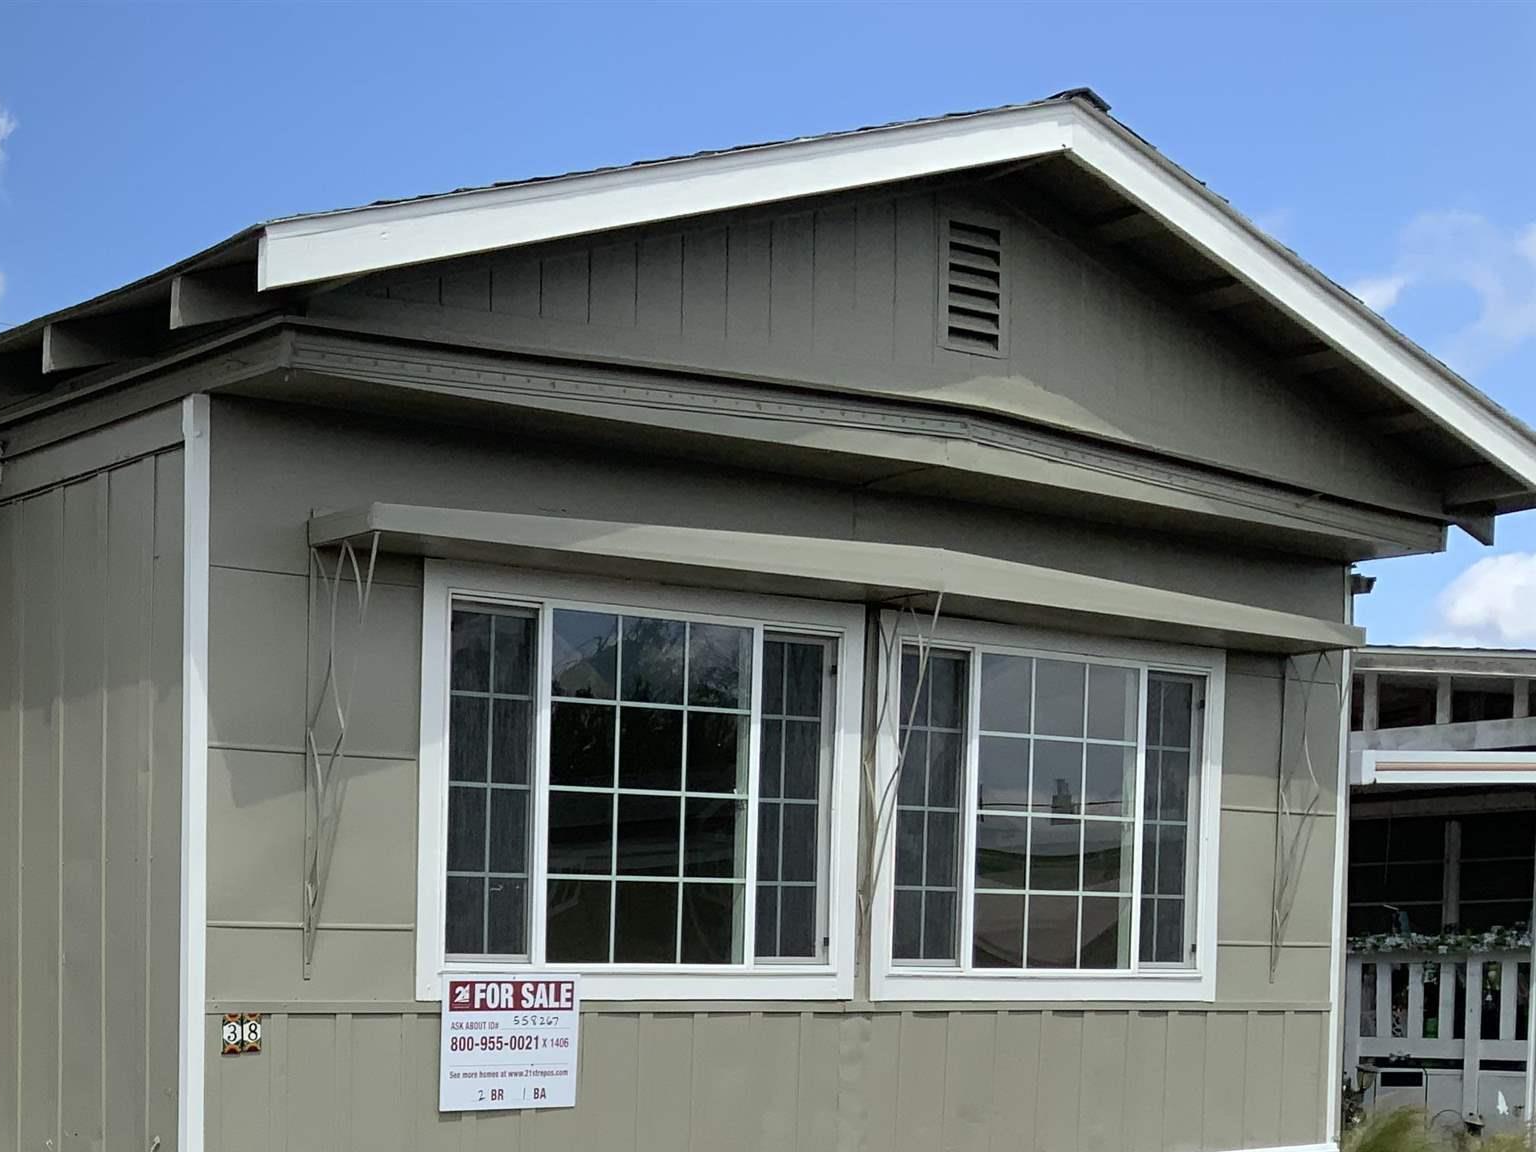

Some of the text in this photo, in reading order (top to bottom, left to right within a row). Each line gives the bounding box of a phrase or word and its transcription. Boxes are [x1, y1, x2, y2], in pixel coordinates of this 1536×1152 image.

[474, 983, 514, 1009] FOR
[521, 983, 572, 1009] SALE
[227, 1022, 259, 1042] 38
[451, 1022, 464, 1030] ASK
[465, 1022, 486, 1030] ABOUT
[488, 1022, 499, 1030] ID#
[451, 1035, 539, 1051] 800-955-0021
[550, 1038, 569, 1048] 1406
[449, 1071, 460, 1079] See
[462, 1071, 477, 1079] more
[479, 1070, 499, 1079] homes
[500, 1070, 507, 1078] at
[491, 1089, 504, 1101] BR
[533, 1088, 546, 1099] BA
